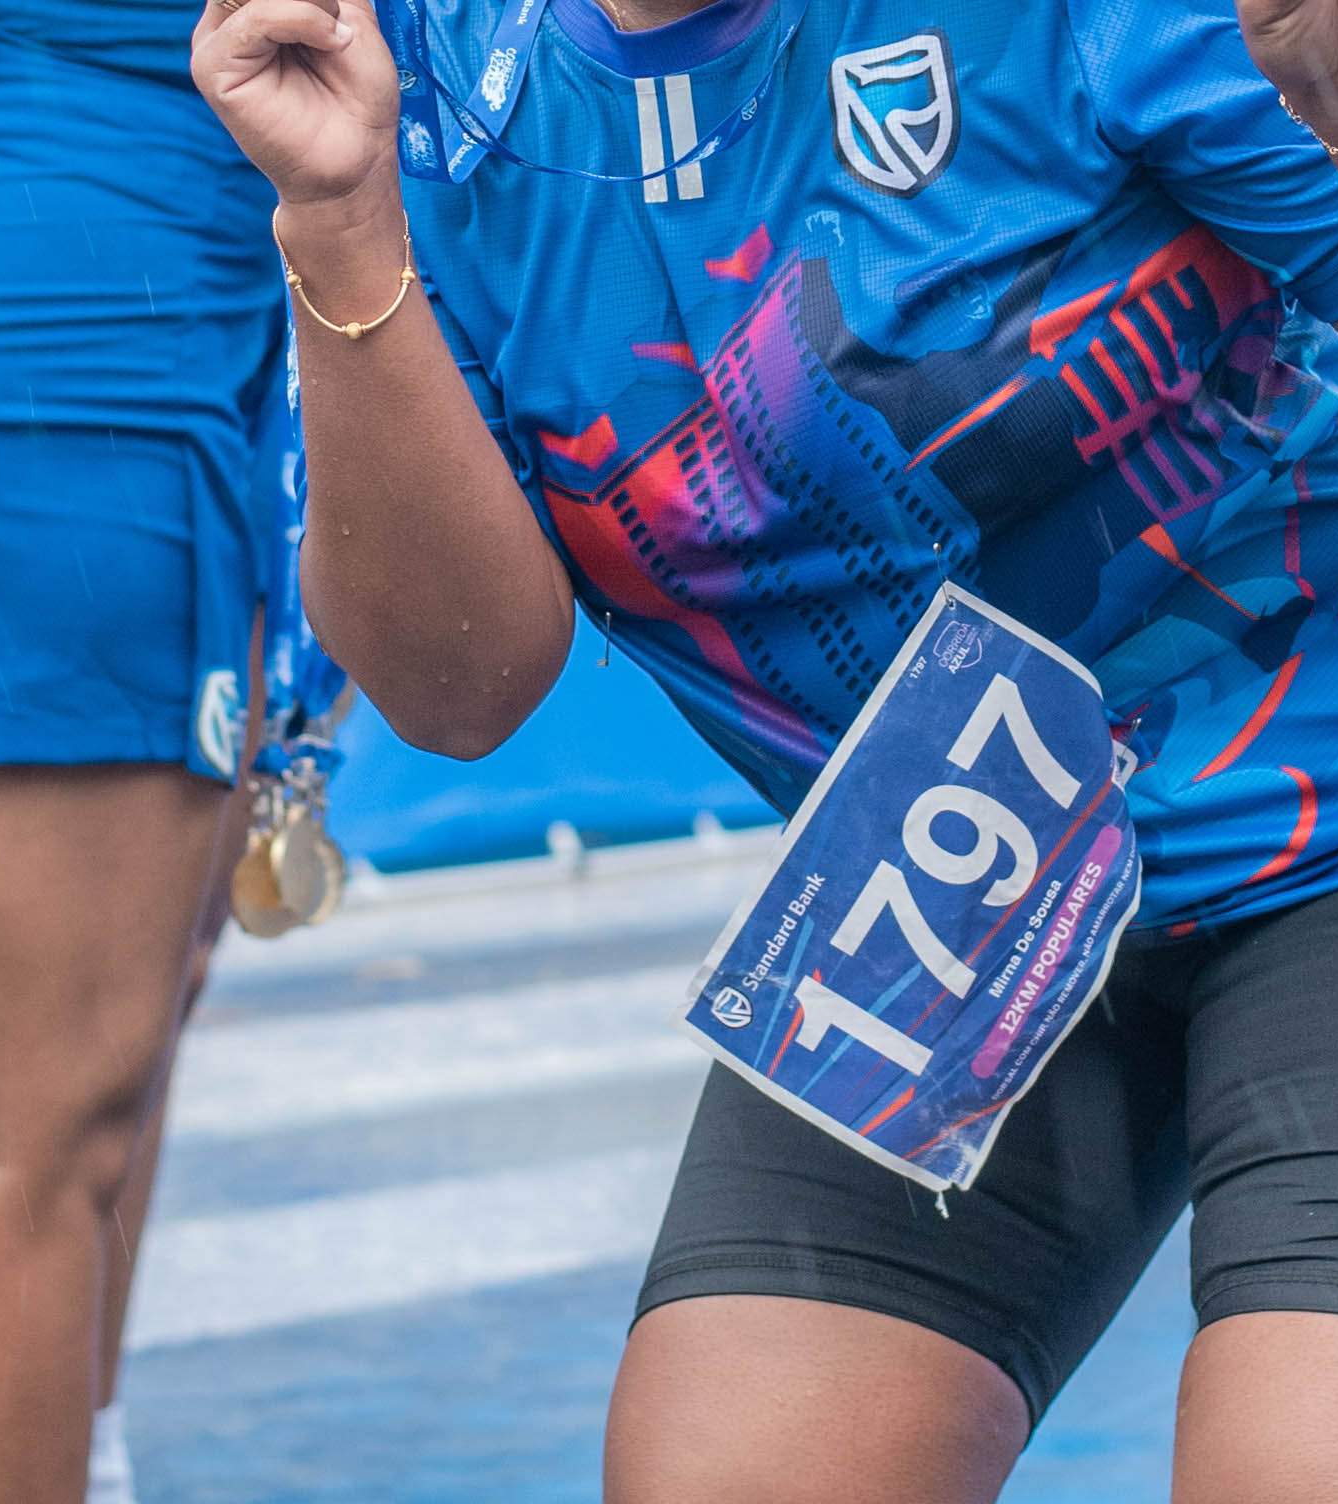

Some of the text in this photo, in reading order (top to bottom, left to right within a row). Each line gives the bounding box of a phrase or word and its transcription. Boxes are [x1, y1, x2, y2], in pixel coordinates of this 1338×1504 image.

[517, 0, 535, 25] Bank
[910, 655, 927, 679] 1797
[938, 623, 971, 668] CORRIDA
[948, 646, 970, 674] AZUL
[794, 673, 1082, 1076] 1797
[742, 873, 826, 991] Standard Bank
[988, 879, 1062, 999] Mirna De Sousa
[999, 861, 1102, 1034] 12KM POPULARES
[1015, 1046, 1032, 1066] COM
